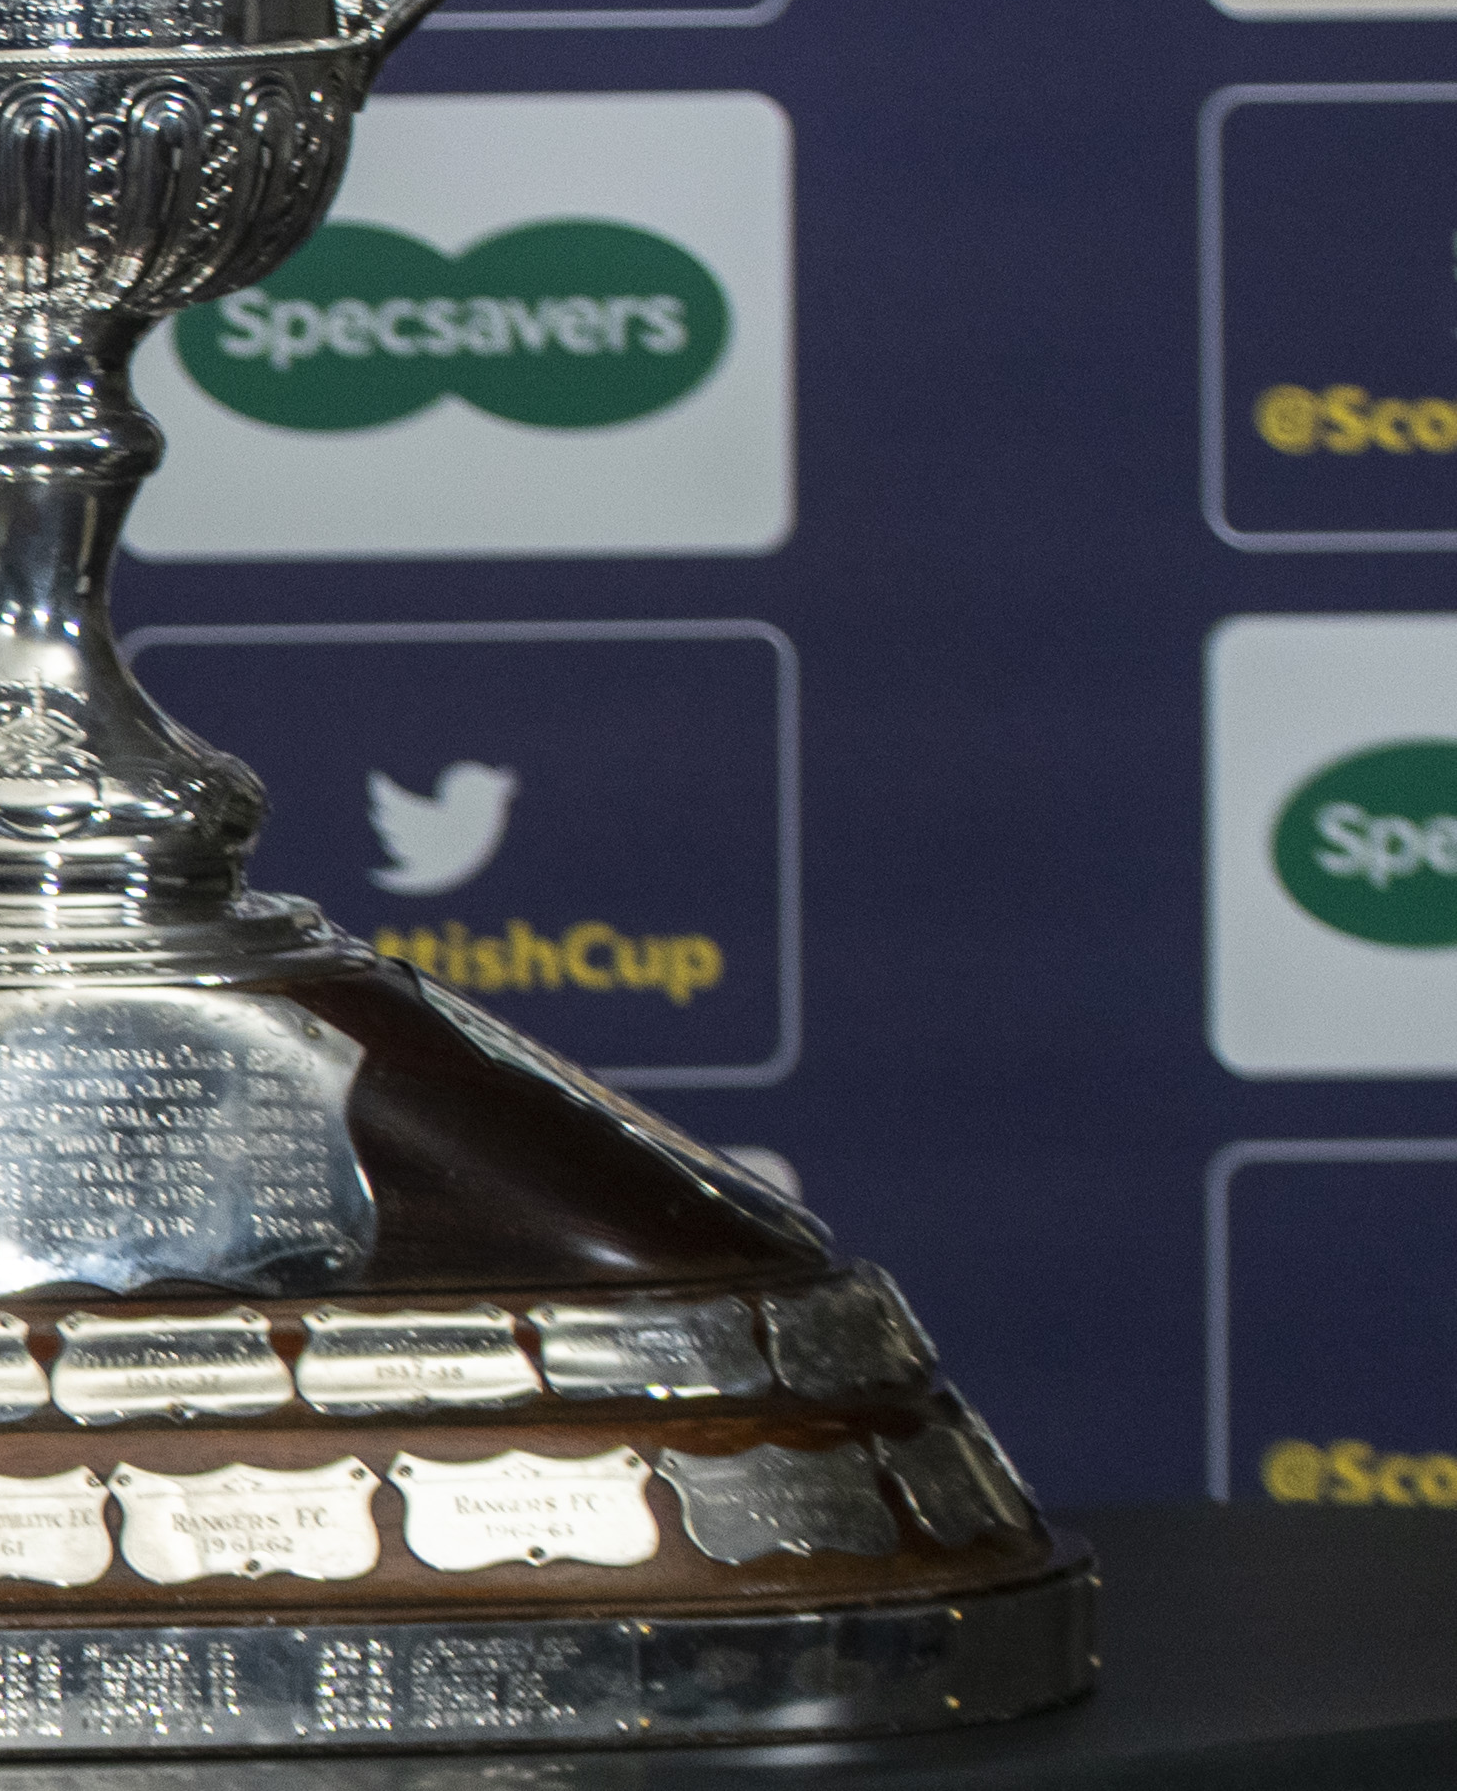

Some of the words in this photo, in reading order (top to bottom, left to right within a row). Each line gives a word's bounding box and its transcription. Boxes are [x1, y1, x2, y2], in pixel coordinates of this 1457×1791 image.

[217, 288, 689, 371] Specsavers
[452, 1493, 560, 1516] RANGERS
[170, 1511, 283, 1534] RANGERS
[199, 1535, 296, 1555] 1961-62
